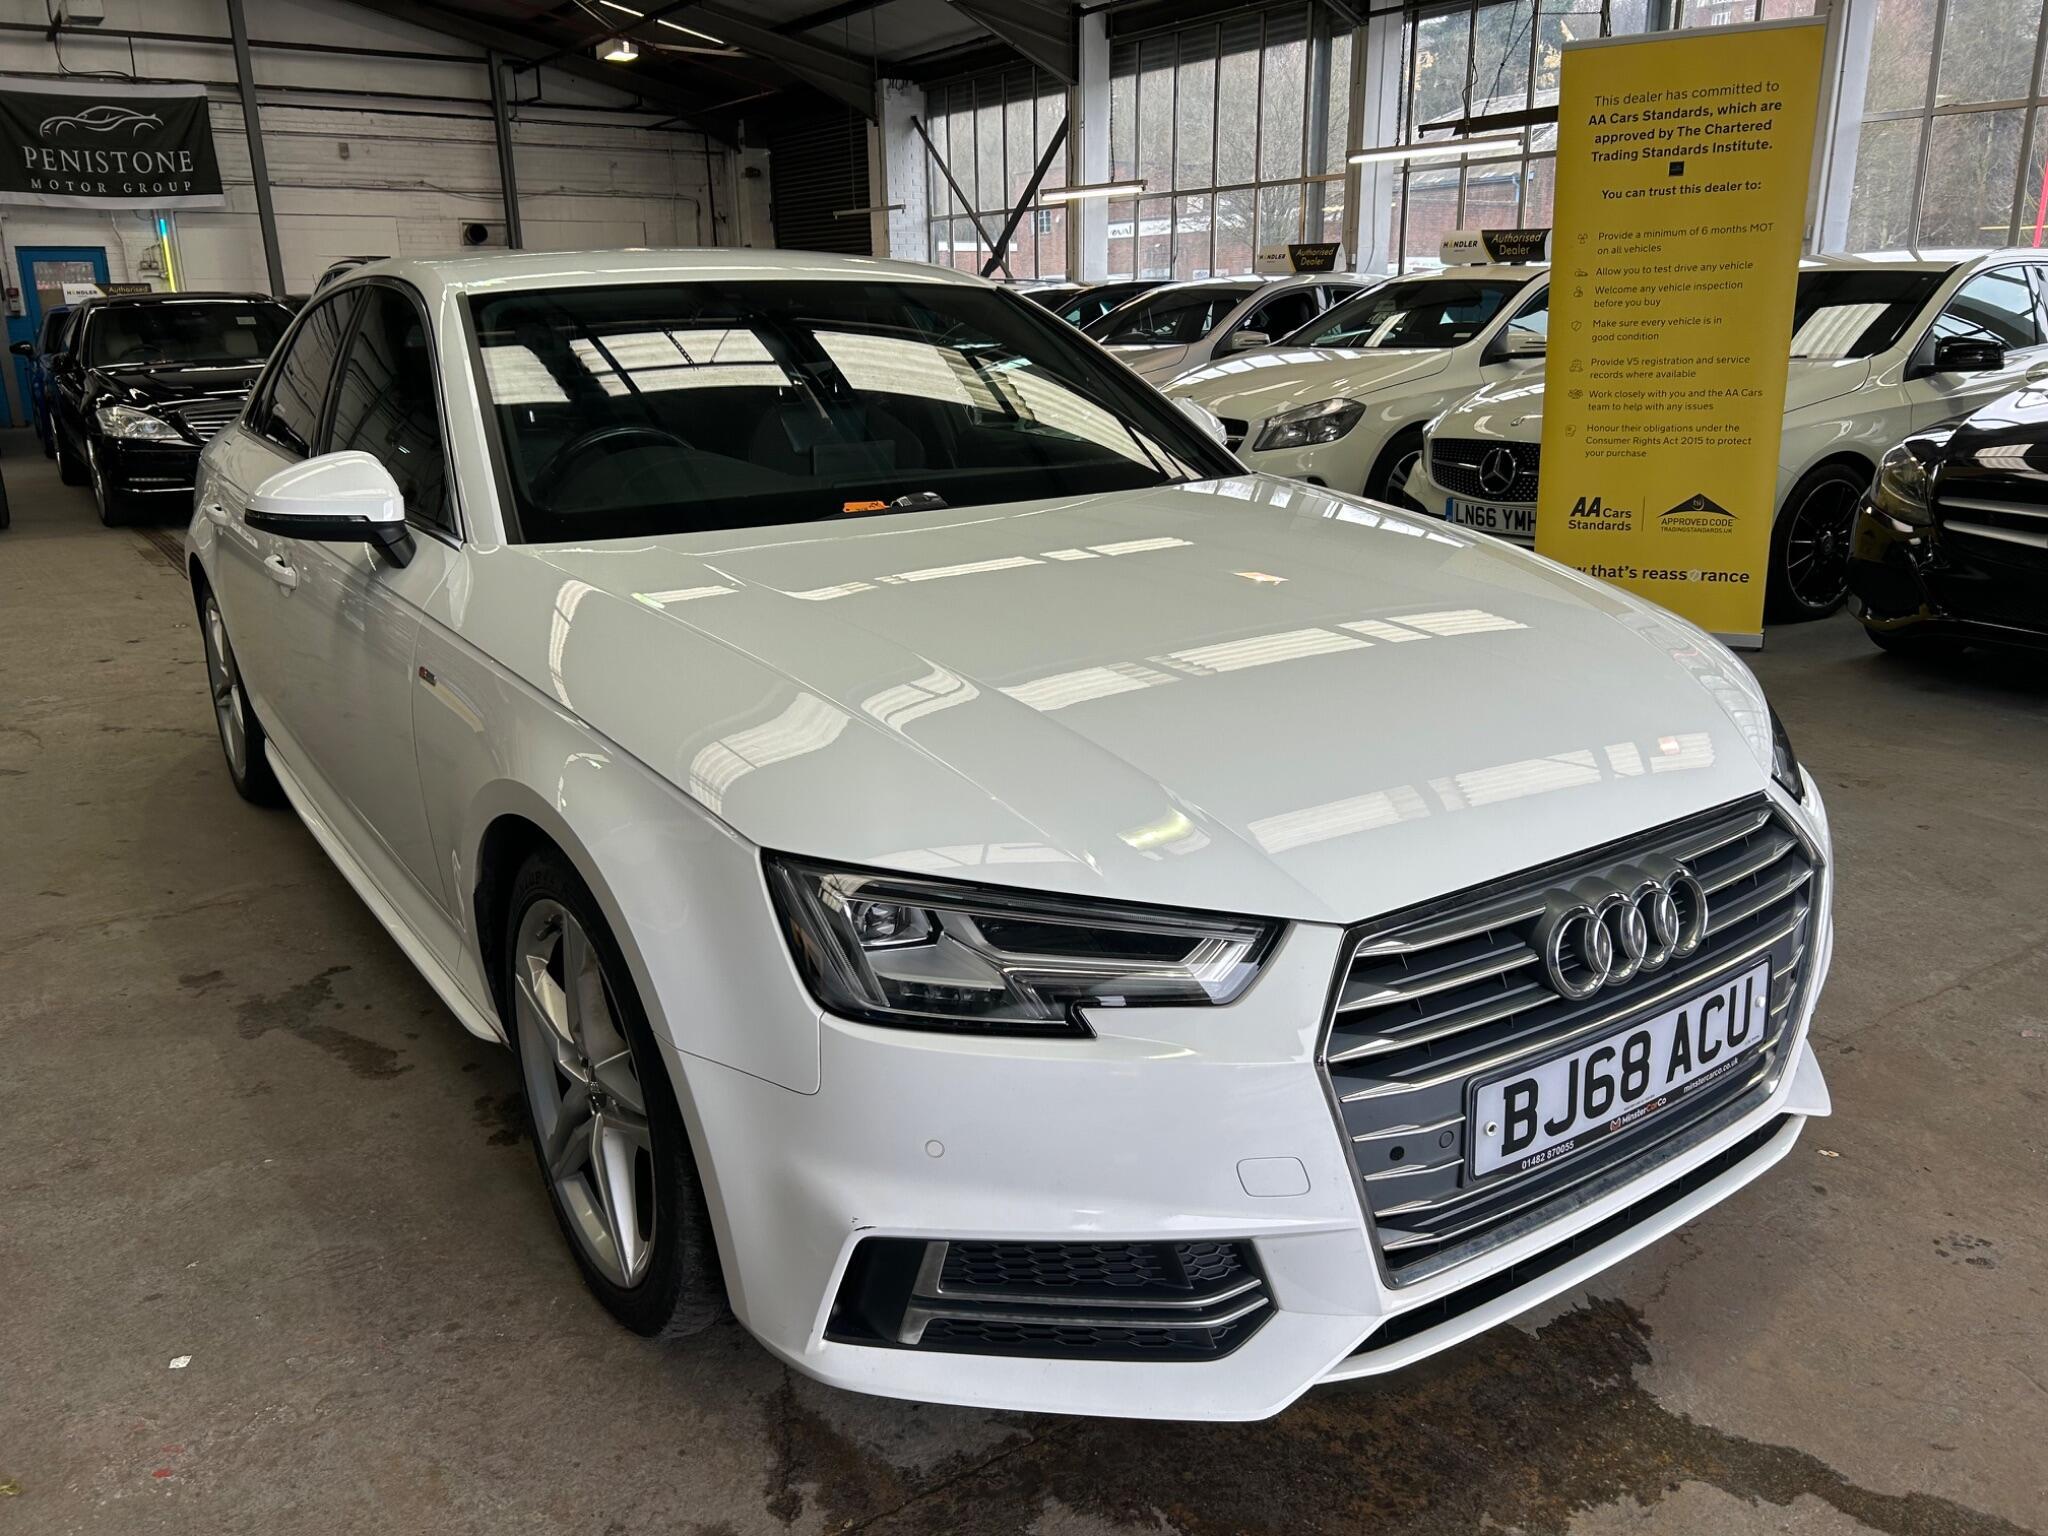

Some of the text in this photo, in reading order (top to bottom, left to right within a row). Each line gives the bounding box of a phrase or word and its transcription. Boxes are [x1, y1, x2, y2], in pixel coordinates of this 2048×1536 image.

[1595, 81, 1779, 107] This dealer has committed to
[1588, 102, 1782, 126] AA Cars Standards, which are
[1594, 120, 1772, 144] approved by The Chartered
[1591, 139, 1773, 162] Trading Standards Institute.
[22, 146, 194, 174] PENISTONE
[31, 178, 192, 193] MOTOR GROUP
[1602, 181, 1762, 200] You can trust this dealer to:
[1492, 232, 1542, 243] Authorised
[1598, 231, 1633, 241] Provide
[1644, 230, 1687, 239] minimum
[1689, 227, 1700, 236] of
[1701, 226, 1708, 235] 6
[1710, 225, 1747, 235] months
[1750, 223, 1774, 232] MOT
[1296, 247, 1334, 256] Authorised
[1500, 245, 1530, 255] Dealer
[1597, 244, 1662, 255] on all vehicles
[1301, 257, 1324, 265] Dealer
[1596, 261, 1753, 277] Allow you to test drive any vehicle
[1595, 281, 1743, 295] Welcome any vehicle inspection
[1594, 299, 1661, 308] before you buy
[1592, 319, 1617, 328] Make
[1641, 320, 1666, 328] every
[1668, 317, 1701, 326] vehicle
[1703, 317, 1711, 325] is
[1713, 316, 1722, 325] in
[1591, 332, 1659, 343] good condition
[1591, 356, 1750, 367] Provide V5 registration and service
[1590, 369, 1696, 379] records where available
[1589, 388, 1763, 399] Work closely with you and the AA Cars
[1612, 403, 1621, 411] to
[1623, 402, 1642, 412] help
[1644, 402, 1664, 411] with
[1666, 404, 1683, 412] any
[1685, 402, 1714, 410] issues
[1587, 424, 1740, 434] Honour their obligations under the
[1586, 437, 1751, 446] Consumer Rights Act 2015 to protect
[1585, 449, 1647, 458] your purchase
[1570, 497, 1632, 519] AA Cars
[1455, 503, 1496, 527] LN66
[1568, 520, 1632, 531] Standards
[1661, 518, 1708, 526] APPROVED
[1591, 565, 1637, 578] that's
[1642, 568, 1750, 583] reassrance
[1501, 977, 1753, 1157] BJ68 ACU
[1522, 1140, 1574, 1169] 01482 870055
